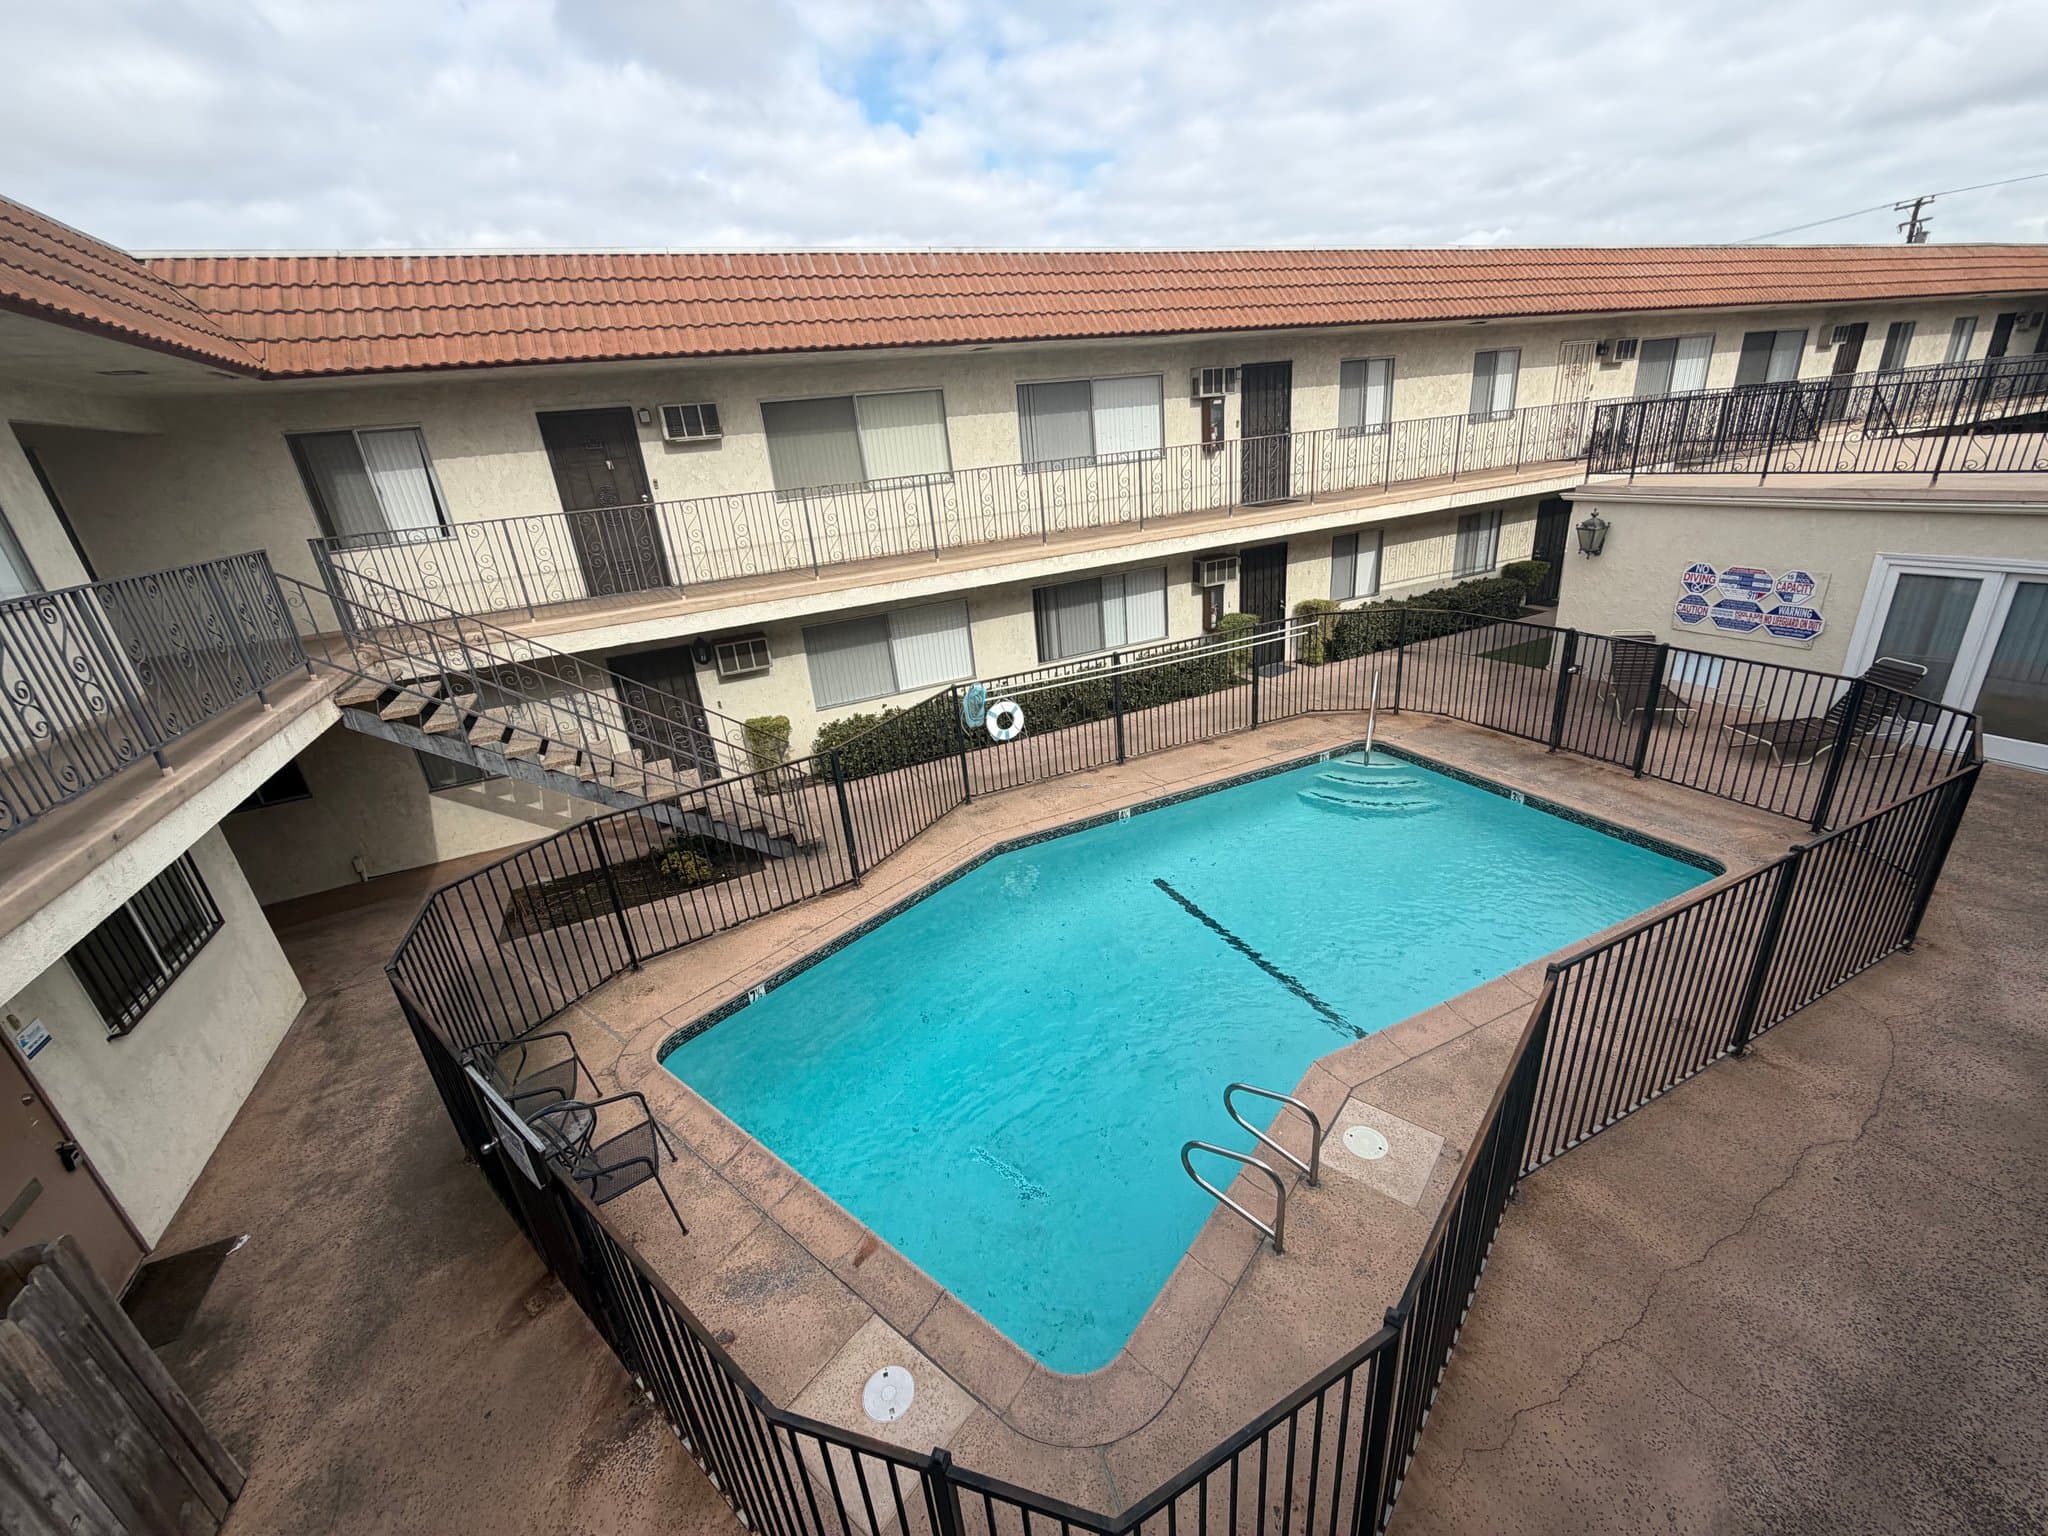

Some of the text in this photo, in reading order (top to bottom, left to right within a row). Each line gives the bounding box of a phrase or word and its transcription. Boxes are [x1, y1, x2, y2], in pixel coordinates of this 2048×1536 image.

[1695, 564, 1709, 574] NO
[1683, 573, 1716, 584] DIVING
[1776, 581, 1815, 595] CAPACITY
[1676, 603, 1708, 616] CAUTION
[1778, 606, 1813, 619] WARNING
[1764, 616, 1772, 625] NO
[1772, 616, 1799, 628] LIFEGUARD
[1800, 618, 1808, 629] ON
[1808, 620, 1822, 632] DUTY
